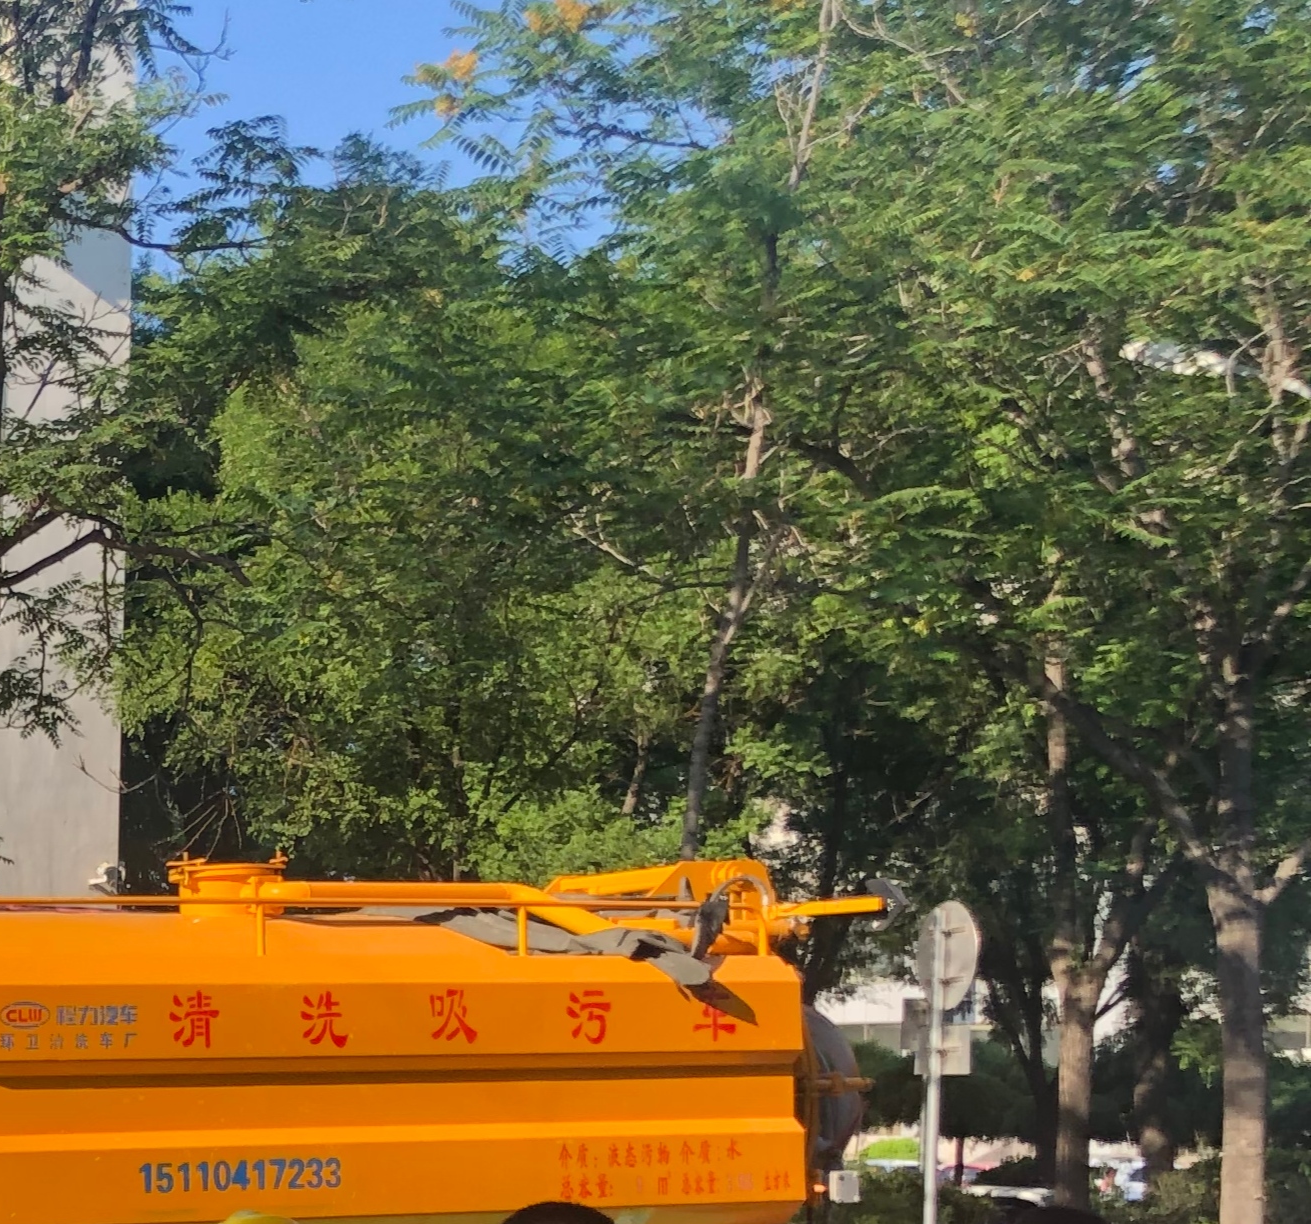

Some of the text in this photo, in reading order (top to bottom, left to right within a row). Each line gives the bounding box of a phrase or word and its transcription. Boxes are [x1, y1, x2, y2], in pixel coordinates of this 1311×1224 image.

[5, 1008, 43, 1023] CLW
[169, 989, 737, 1048] 清洗吸污车
[138, 1157, 342, 1194] 15110417233
